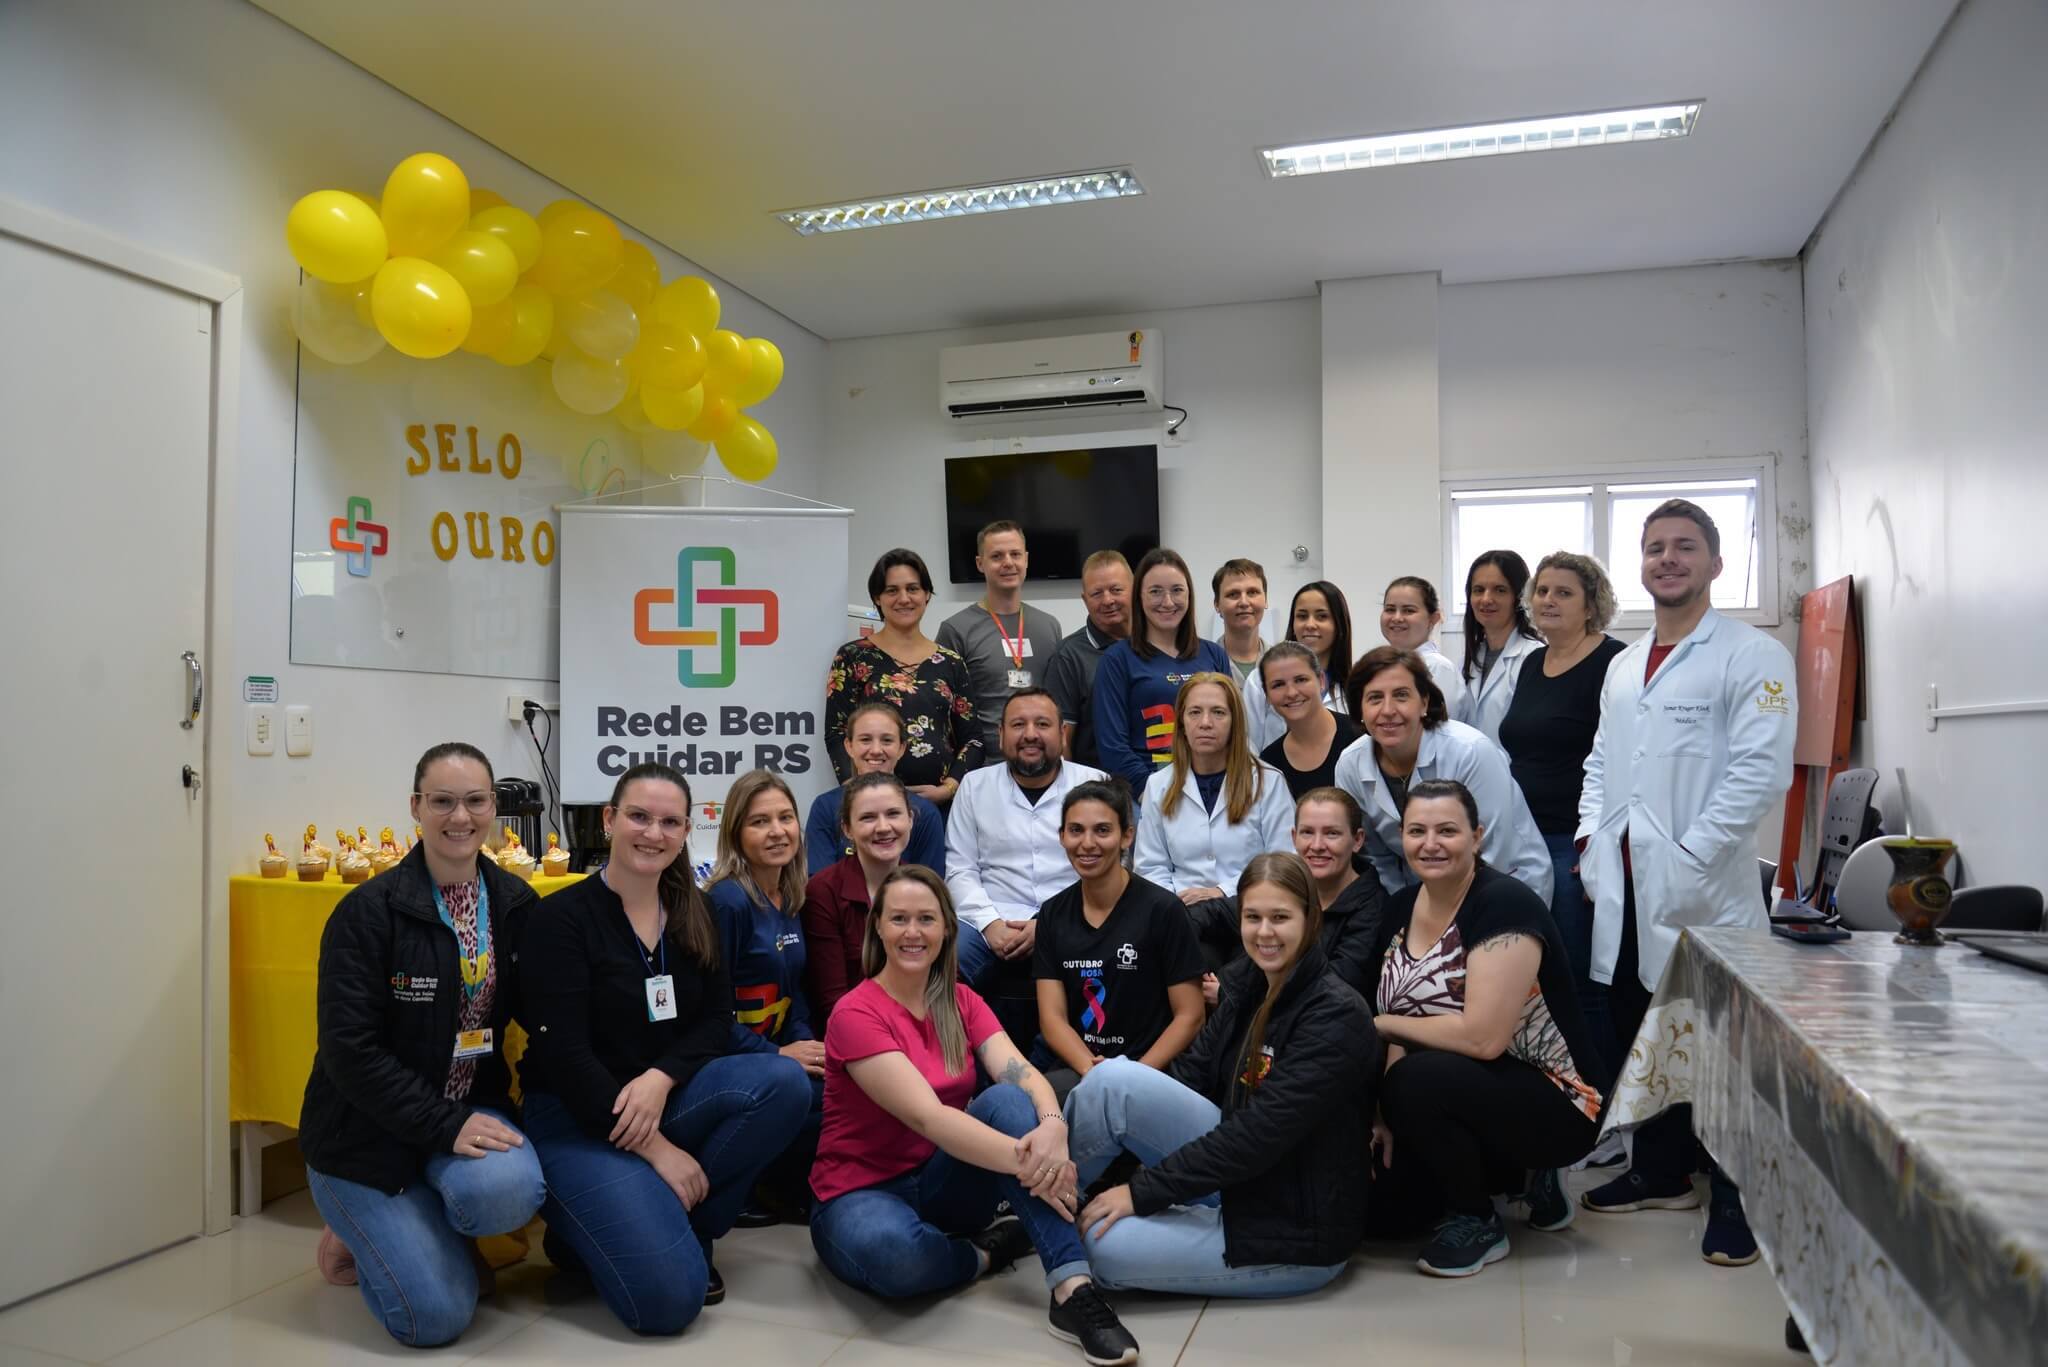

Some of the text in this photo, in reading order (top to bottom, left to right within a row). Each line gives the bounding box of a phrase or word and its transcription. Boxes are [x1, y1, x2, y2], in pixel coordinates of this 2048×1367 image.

[405, 423, 522, 480] SELO
[431, 511, 555, 567] OURO
[1756, 695, 1789, 706] UPF
[597, 705, 815, 737] Rede Bem
[597, 743, 811, 776] Cuidar RS
[696, 823, 721, 831] Cuidar
[1063, 959, 1103, 969] OUTUBRO
[1081, 969, 1104, 977] ROSA
